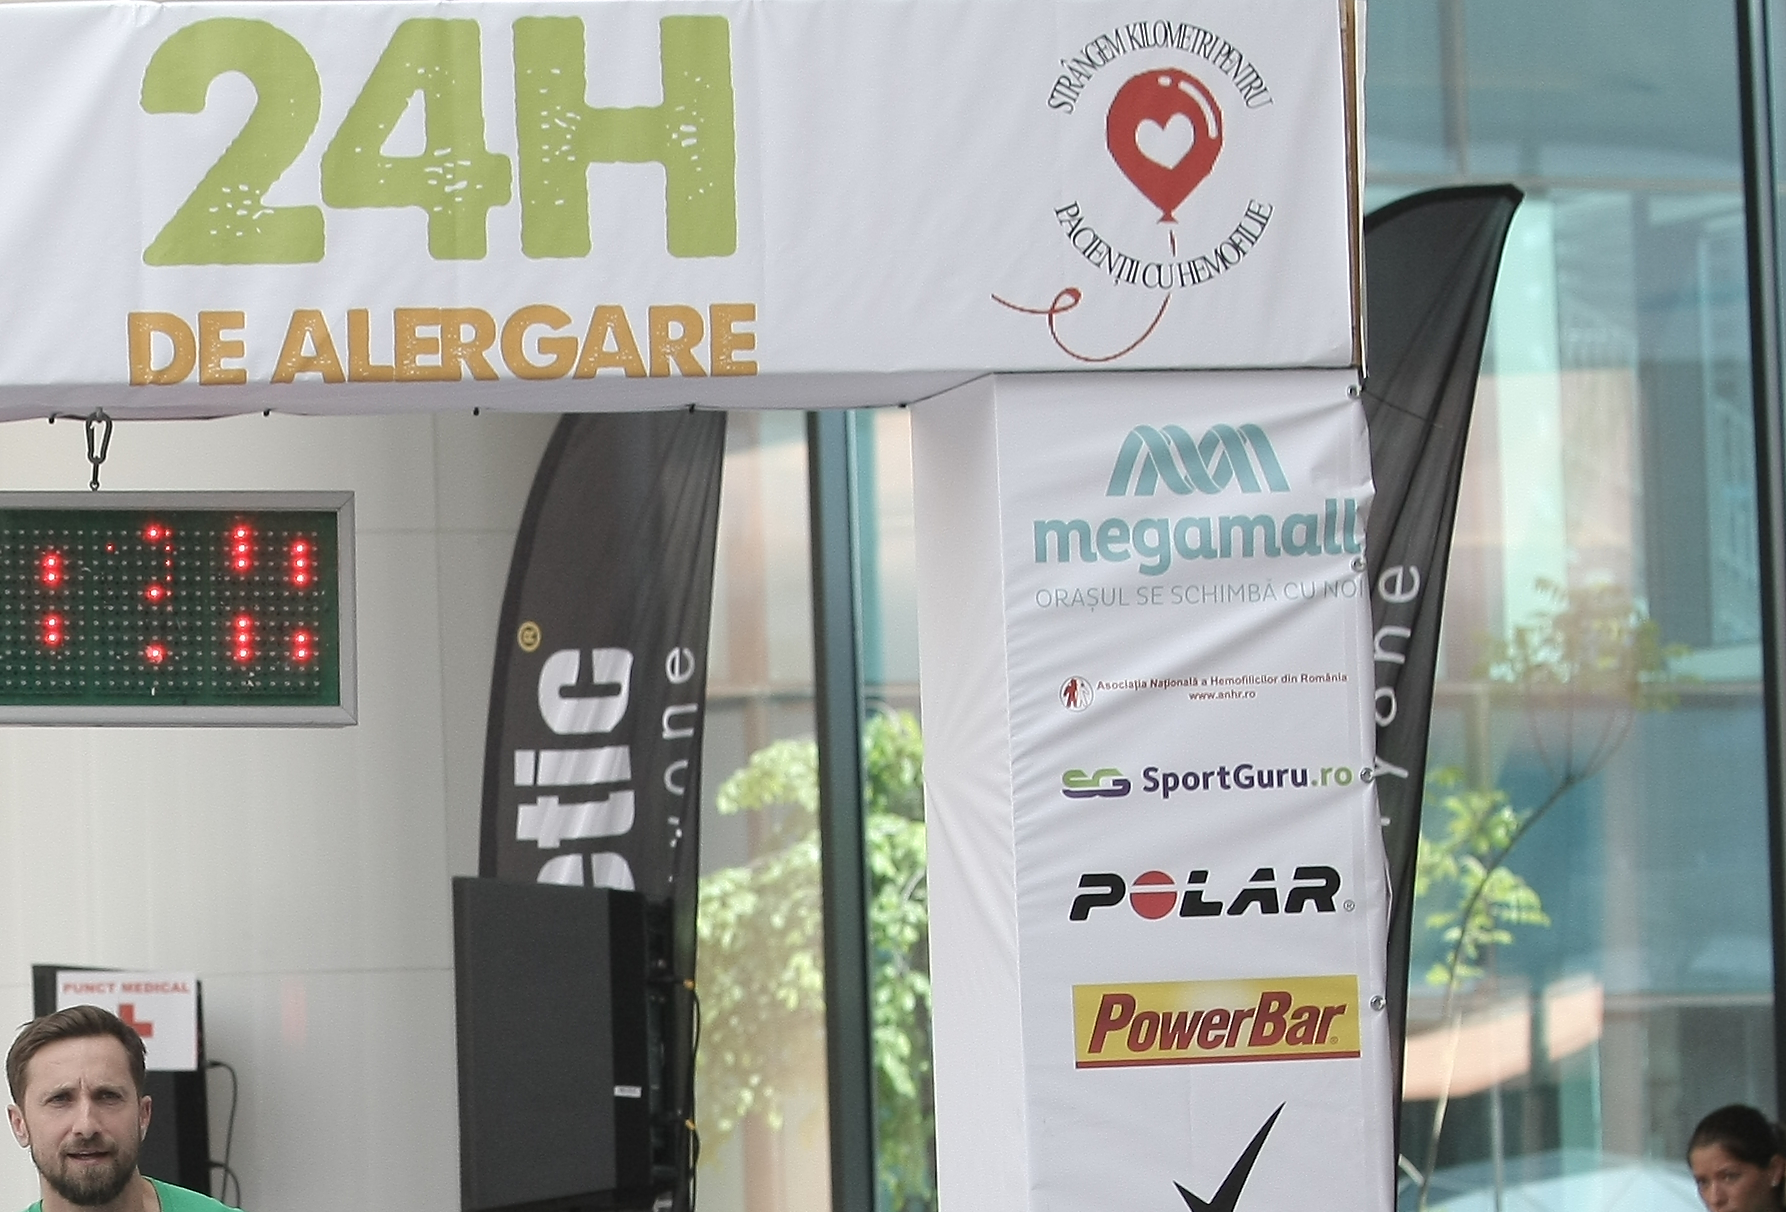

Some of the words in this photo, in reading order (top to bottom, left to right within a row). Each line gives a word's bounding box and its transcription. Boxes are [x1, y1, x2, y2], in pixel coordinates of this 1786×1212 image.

[1211, 43, 1274, 113] PENTRU
[138, 14, 739, 267] 24H
[1143, 261, 1176, 291] CU
[1176, 198, 1274, 287] HEMOFILIE
[127, 309, 247, 388] DE
[270, 303, 758, 386] ALERGARE
[1034, 498, 1361, 576] megamall
[1136, 586, 1166, 606] SE
[1170, 578, 1276, 606] SCHIMBĂ
[1284, 582, 1316, 602] CU
[1189, 689, 1256, 700] www.anhr.ro
[1201, 679, 1207, 687] a
[1281, 673, 1298, 683] din
[1301, 672, 1347, 683] România
[1142, 764, 1353, 799] SportGuru.ro
[1069, 866, 1342, 922] POLAR
[62, 981, 116, 995] PUNCT
[121, 980, 190, 995] MEDICAL
[1087, 990, 1346, 1055] PowerBar
